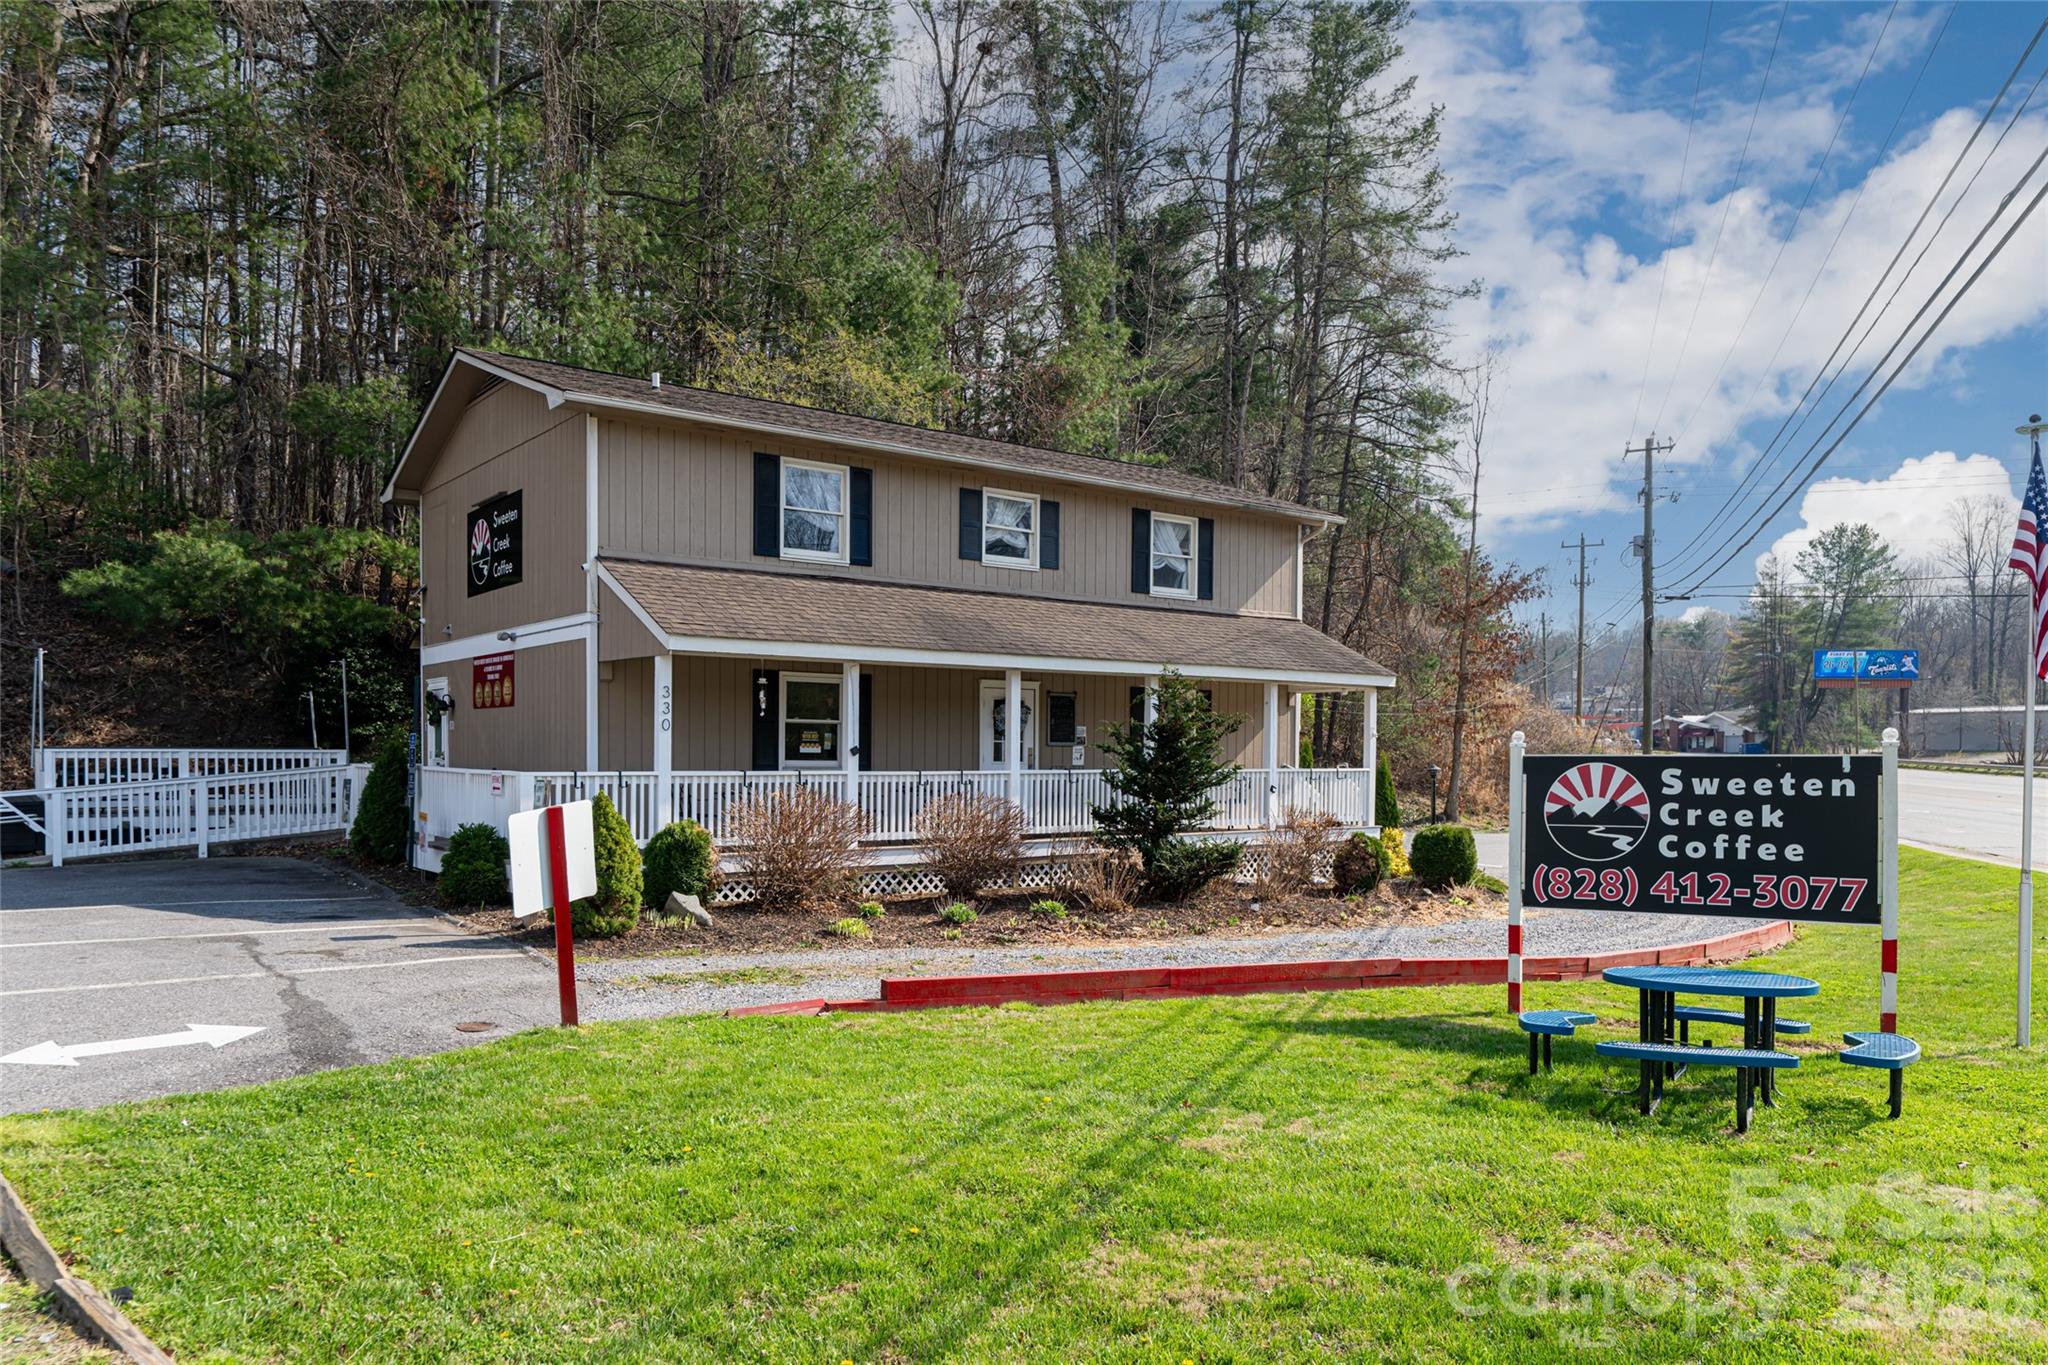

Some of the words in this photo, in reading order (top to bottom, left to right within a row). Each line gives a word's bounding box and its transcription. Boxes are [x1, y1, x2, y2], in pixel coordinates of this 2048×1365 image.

[493, 509, 518, 528] Sweeten
[492, 533, 511, 553] Creek
[492, 560, 513, 578] Coffee
[661, 685, 671, 732] 330
[1660, 768, 1856, 798] Sweeten
[1659, 802, 1784, 829] Creek
[1657, 834, 1805, 863] Coffee
[1532, 863, 1639, 907] (828)
[1649, 870, 1869, 913] 412-3077
